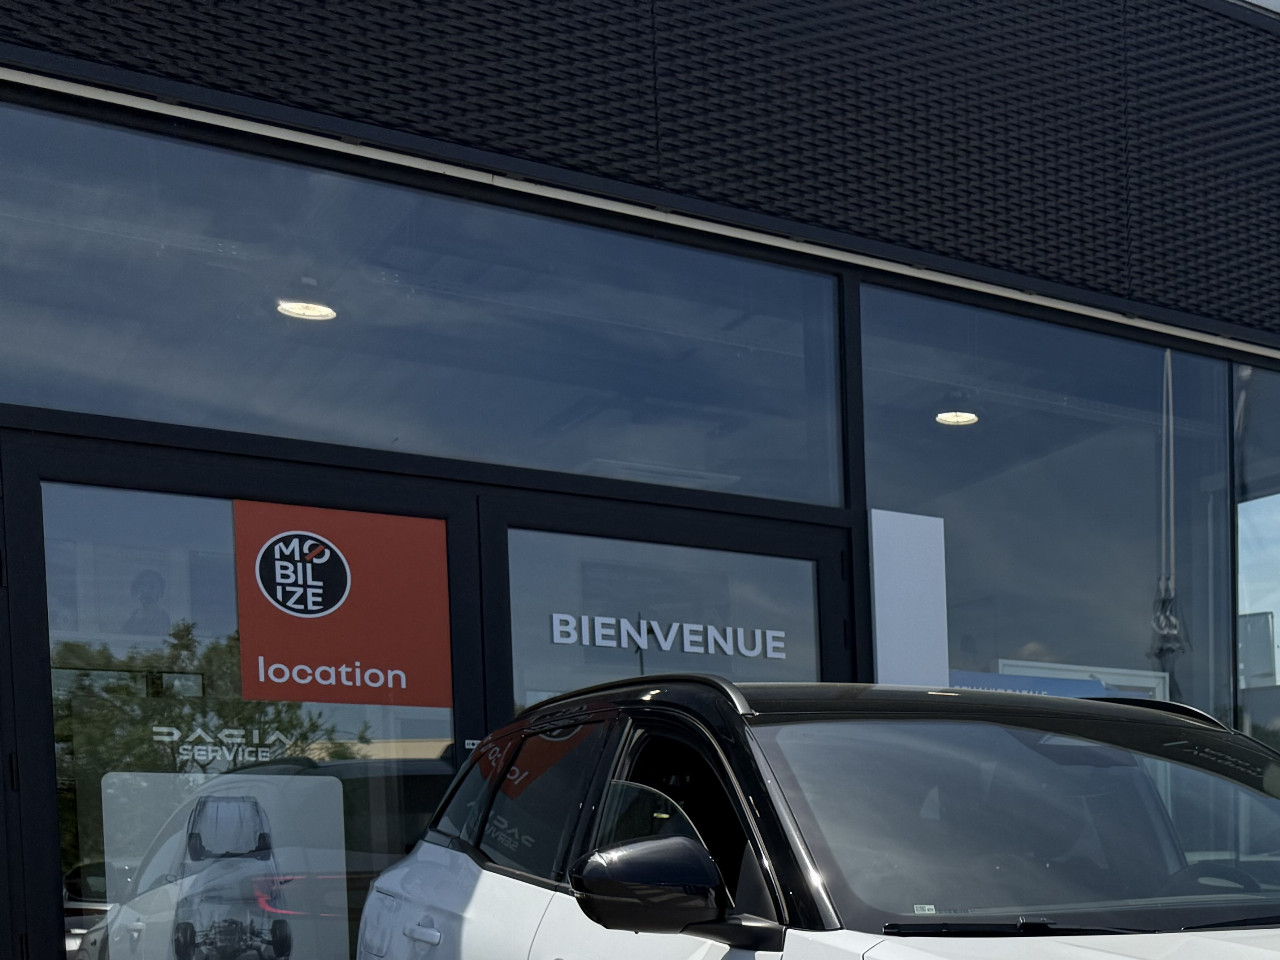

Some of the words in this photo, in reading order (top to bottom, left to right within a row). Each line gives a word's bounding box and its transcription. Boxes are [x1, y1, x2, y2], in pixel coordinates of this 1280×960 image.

[551, 612, 787, 660] BIENVENUE
[258, 656, 407, 689] location
[152, 726, 294, 745] DACIA
[178, 744, 271, 762] SERVICE
